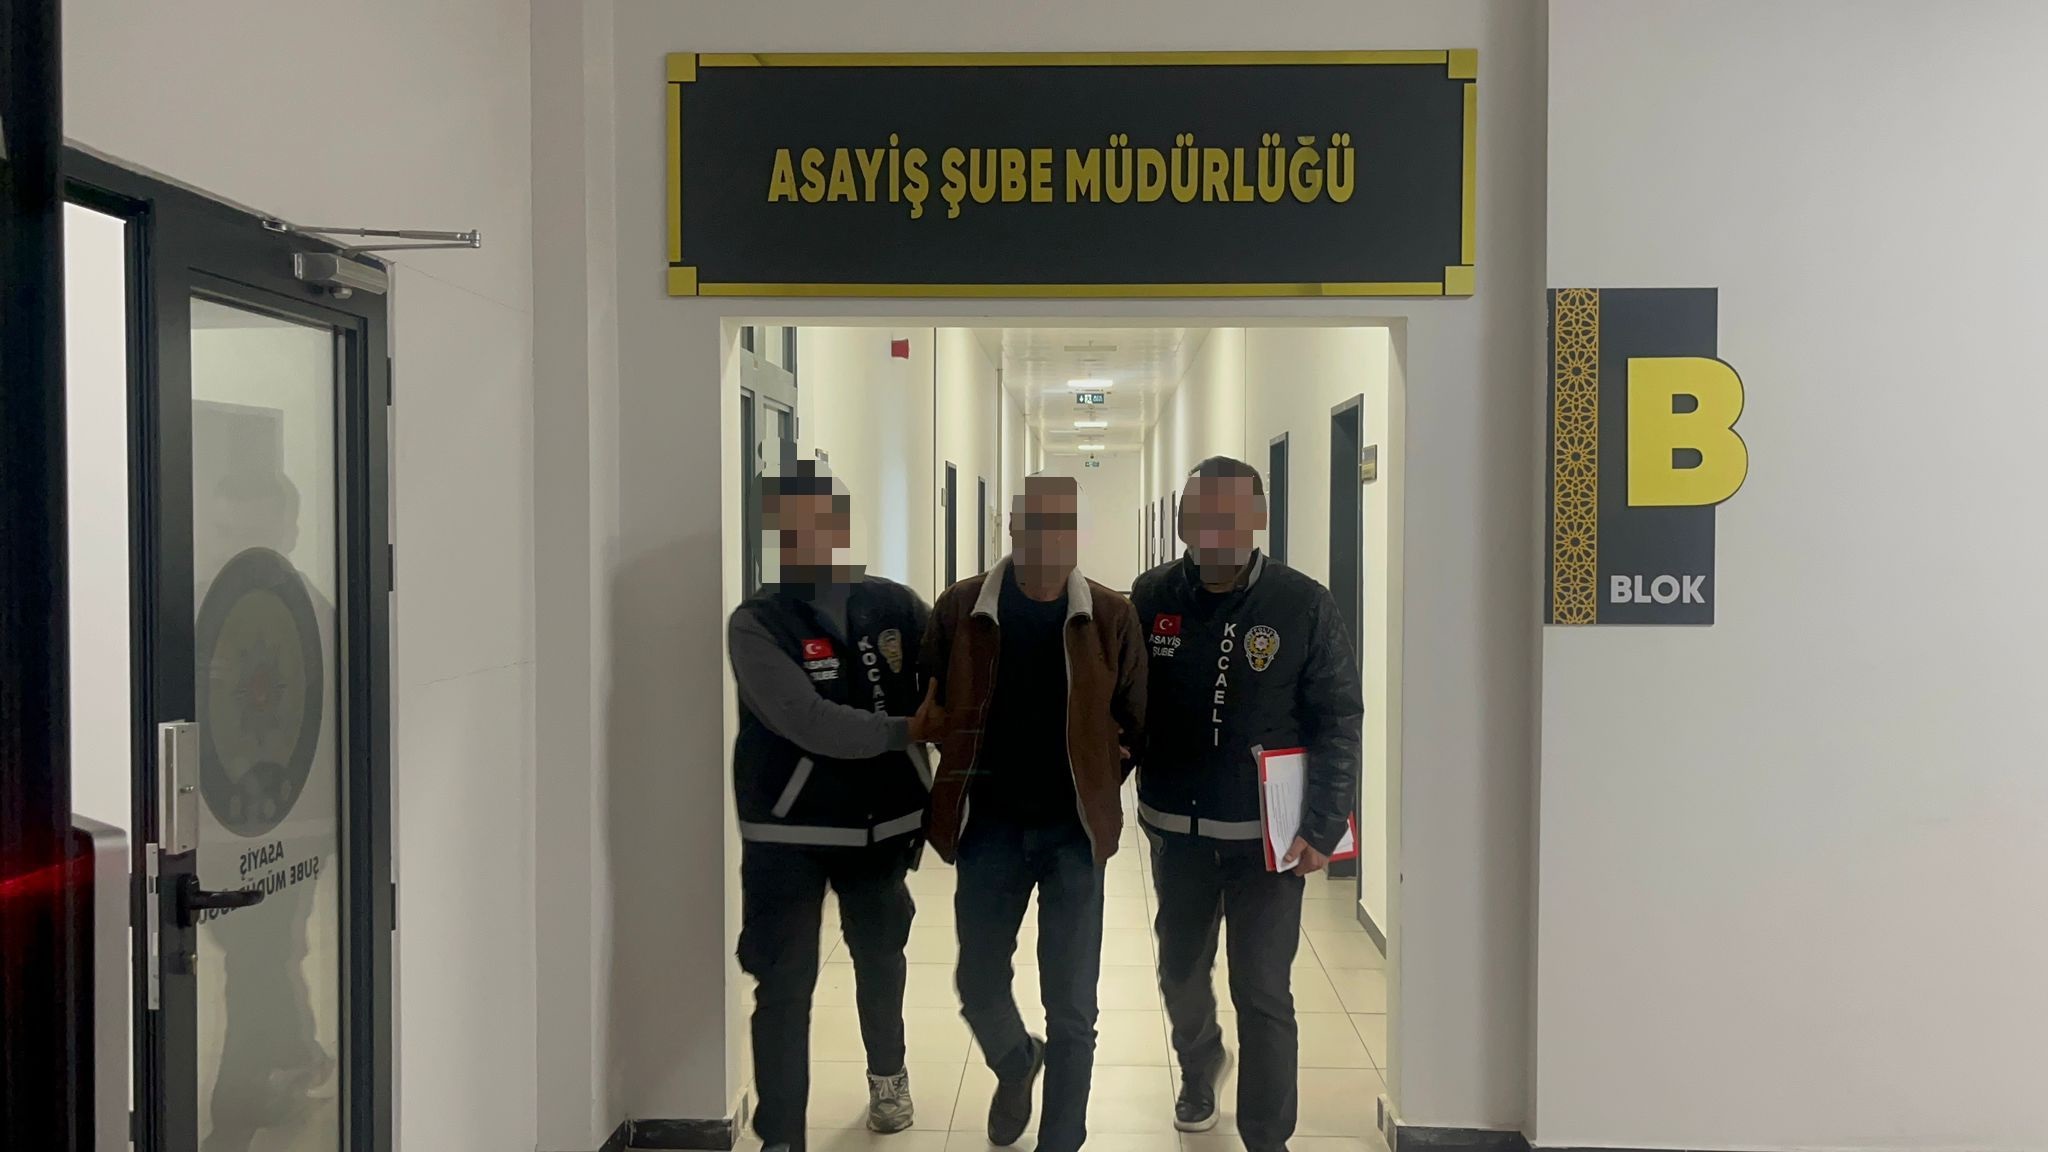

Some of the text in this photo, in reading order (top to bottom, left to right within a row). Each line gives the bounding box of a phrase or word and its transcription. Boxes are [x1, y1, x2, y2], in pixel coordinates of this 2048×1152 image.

[767, 132, 1356, 219] ASAYİŞ ŞUBE MÜDÜRLÜĞÜ
[1627, 356, 1748, 506] B
[1610, 574, 1707, 605] BLOK
[1148, 633, 1182, 649] ASAYİŞ
[1152, 646, 1175, 658] ŞUBE
